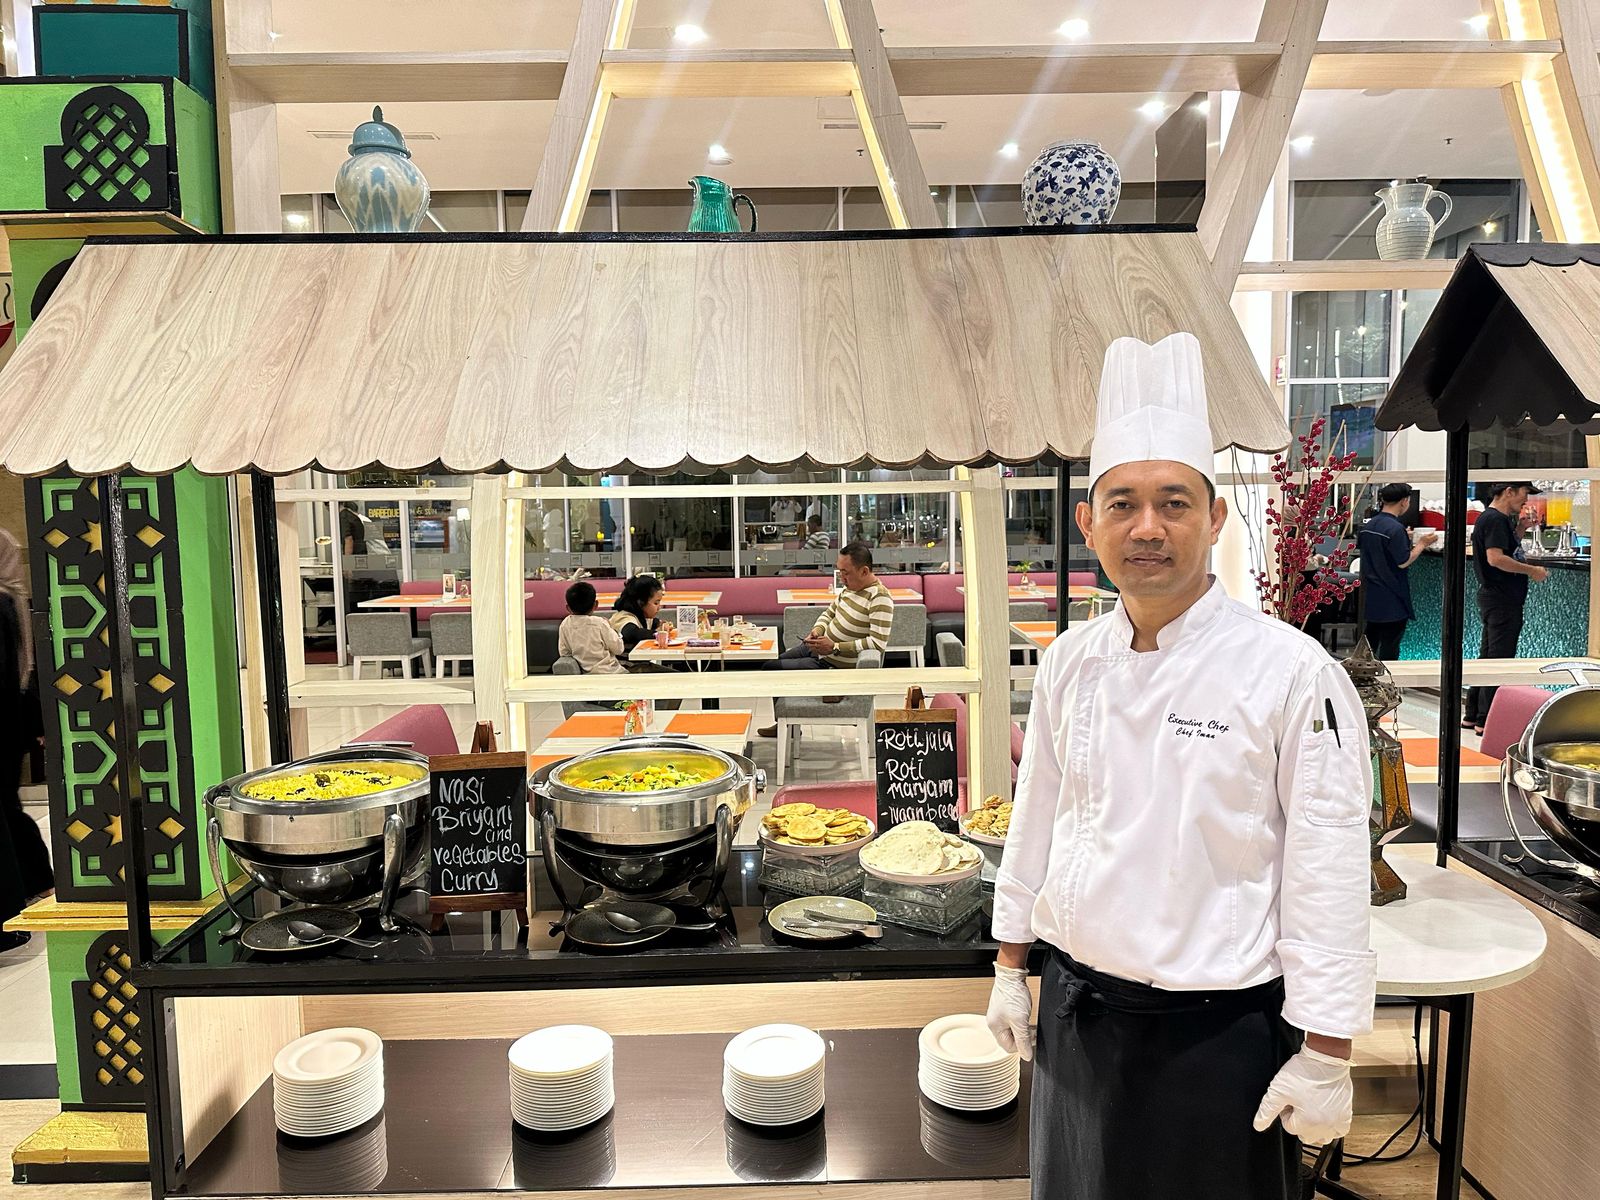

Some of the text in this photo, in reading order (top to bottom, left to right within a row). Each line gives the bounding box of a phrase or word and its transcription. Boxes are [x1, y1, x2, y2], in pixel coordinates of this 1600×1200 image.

[1167, 712, 1230, 733] Executive Chef
[1175, 726, 1193, 738] Chef
[431, 796, 513, 835] Briyani
[485, 822, 513, 844] and
[441, 868, 499, 893] Curry
